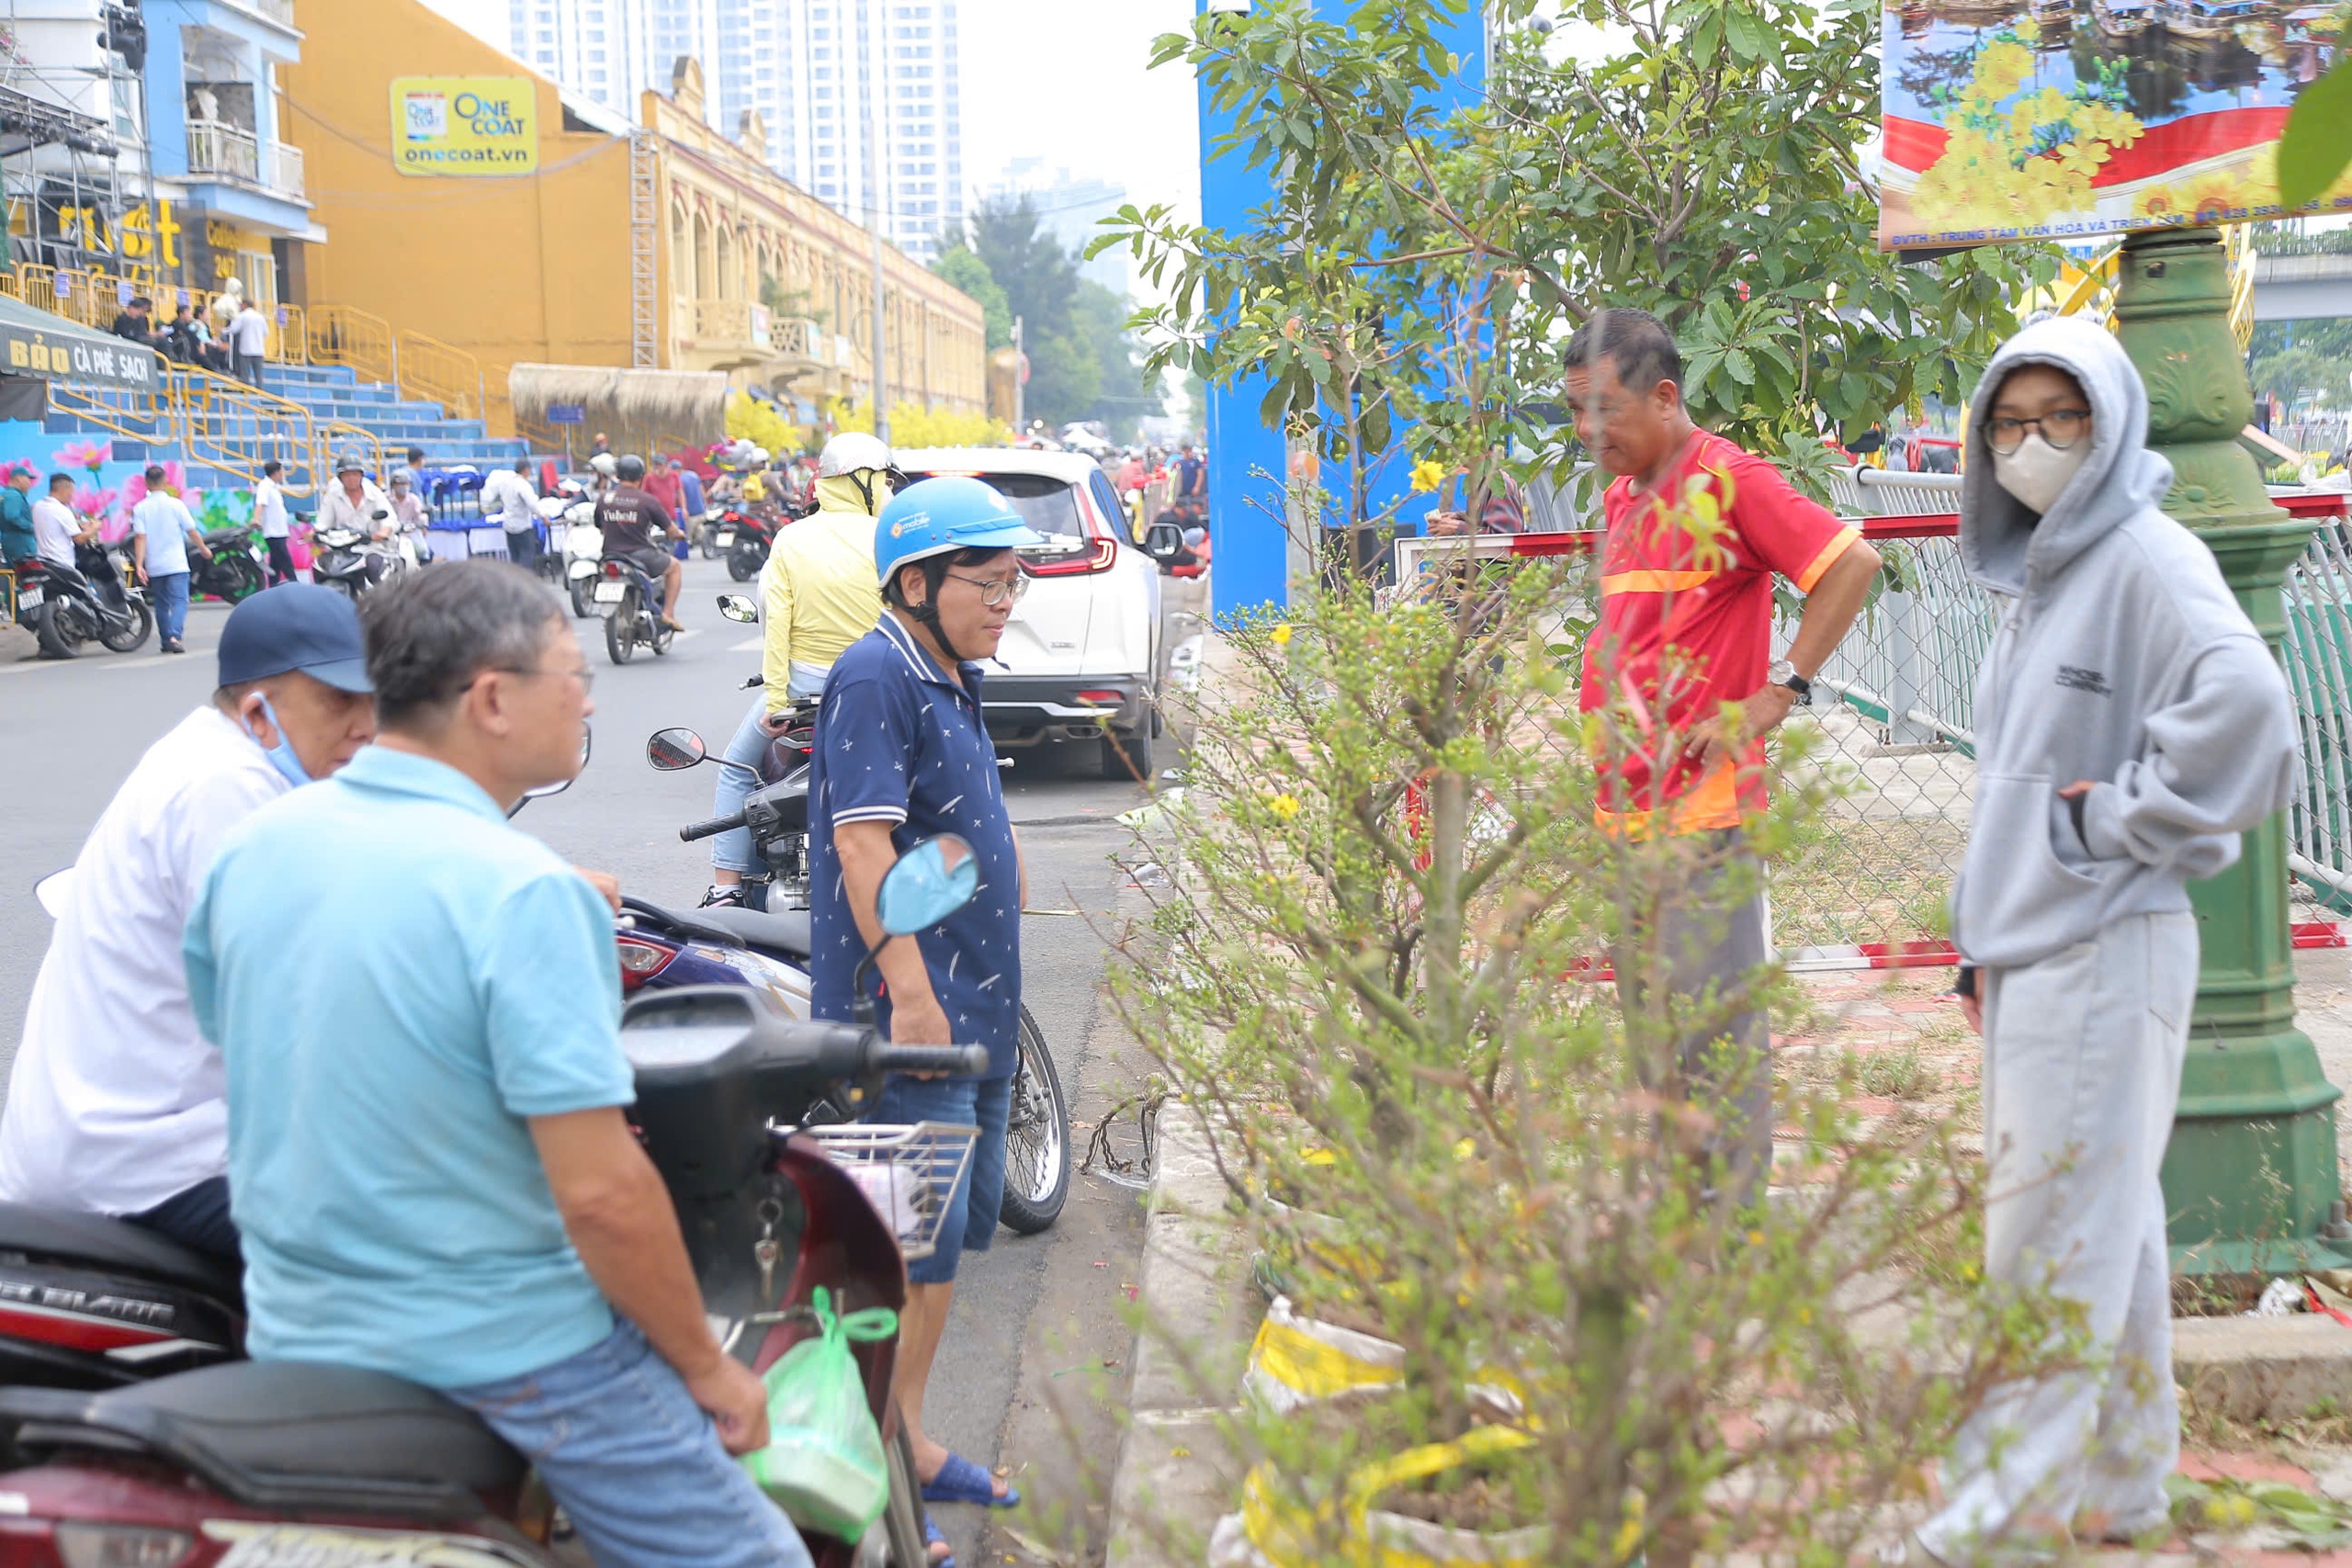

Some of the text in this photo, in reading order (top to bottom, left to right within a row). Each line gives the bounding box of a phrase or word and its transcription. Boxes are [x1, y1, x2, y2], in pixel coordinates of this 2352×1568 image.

[455, 93, 509, 118] ONE
[472, 118, 525, 135] COAT
[406, 147, 527, 162] onecoat.vn
[1939, 230, 1986, 243] TRUNG
[9, 333, 149, 385] BẢO CÀ PHÊ SẠCH
